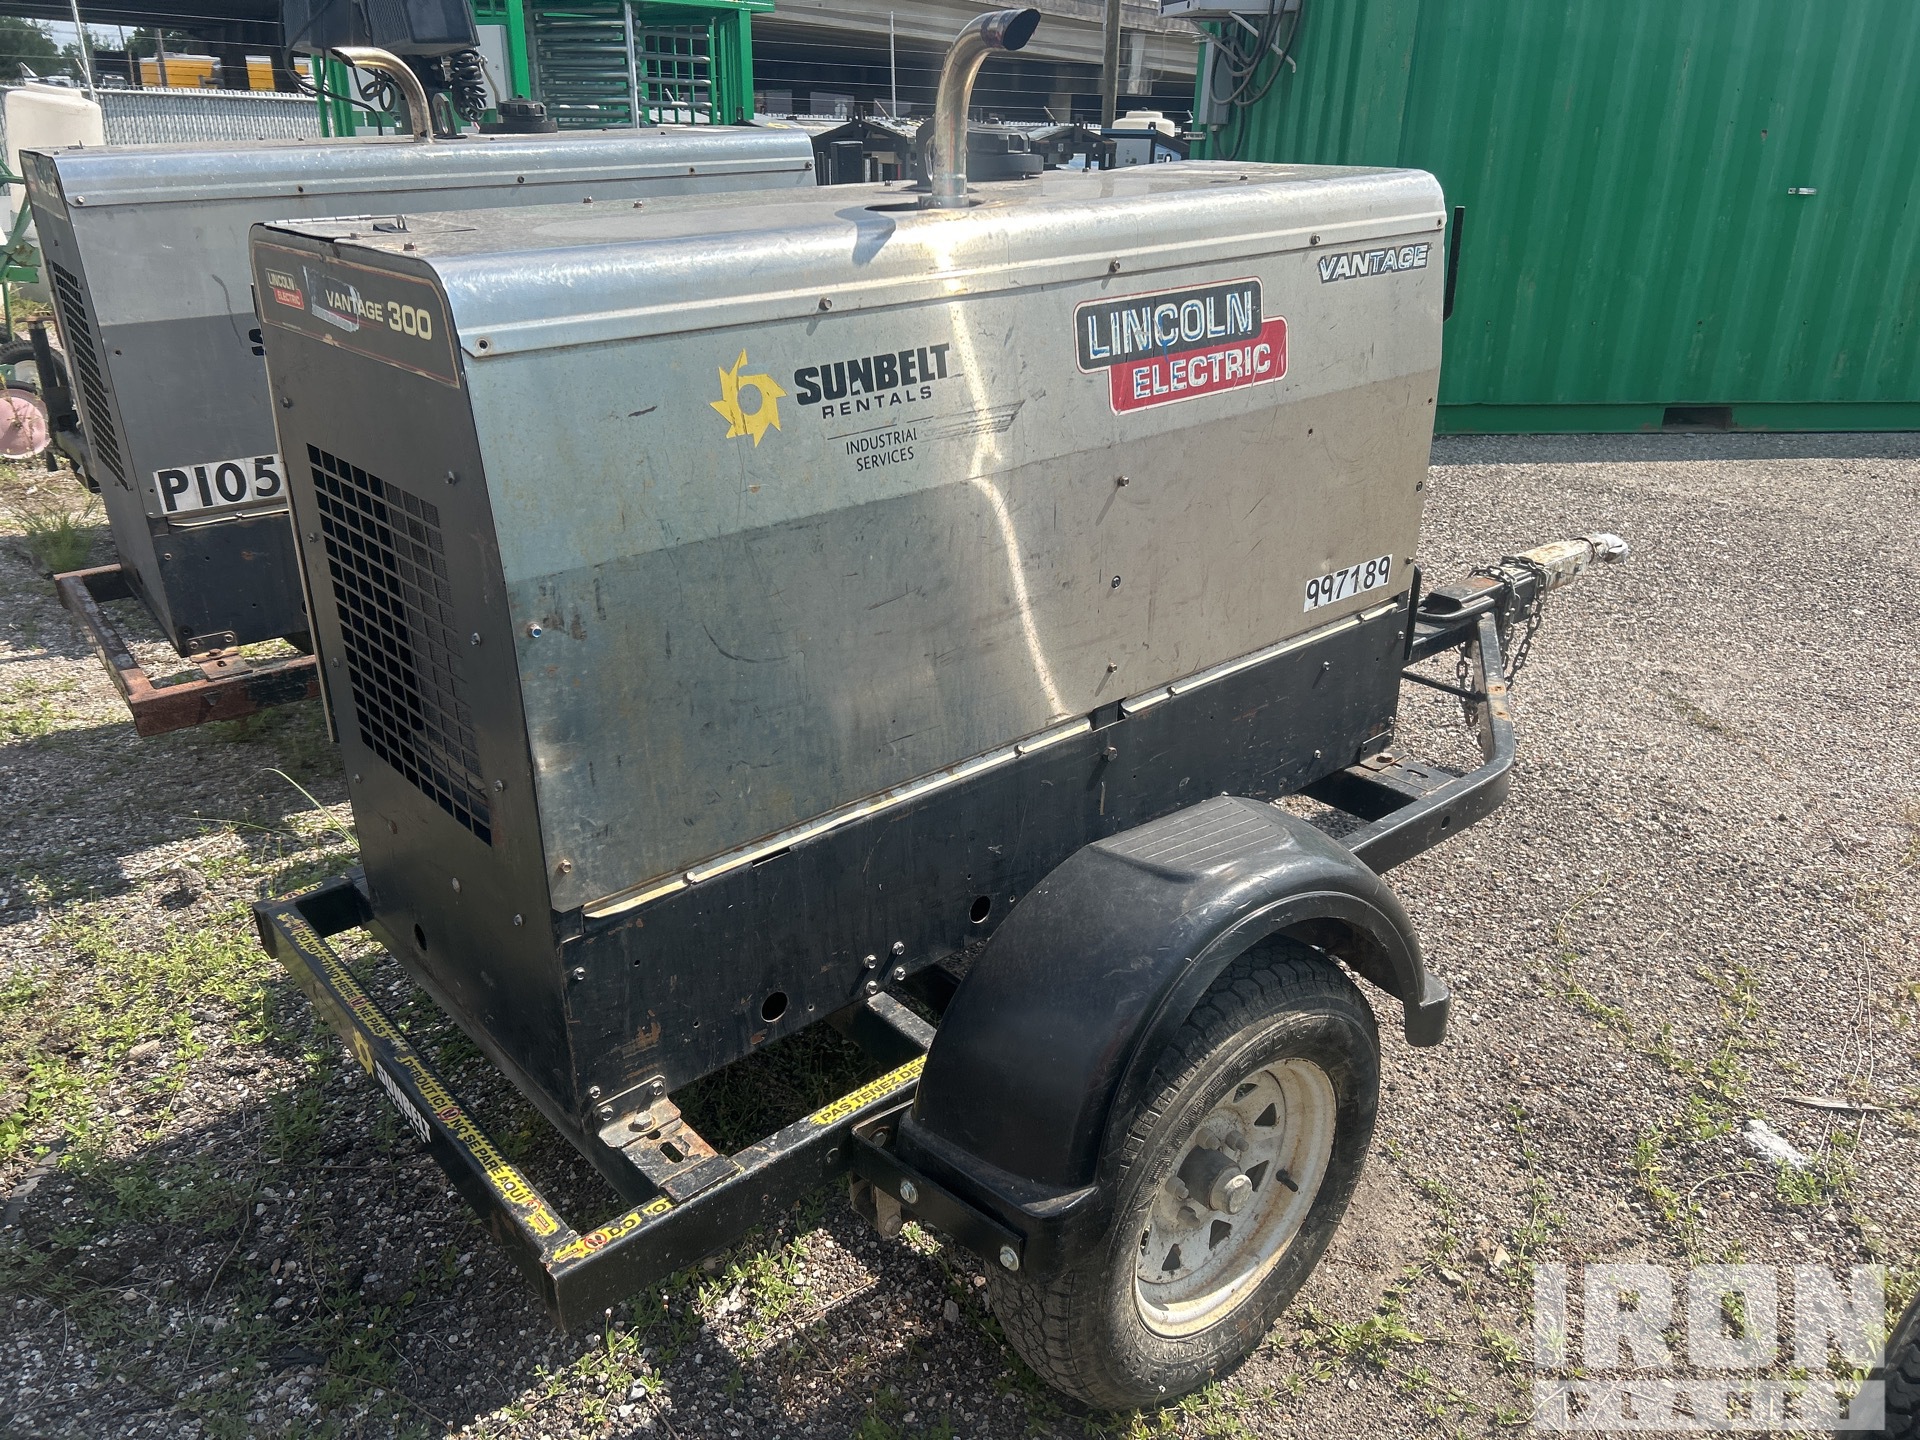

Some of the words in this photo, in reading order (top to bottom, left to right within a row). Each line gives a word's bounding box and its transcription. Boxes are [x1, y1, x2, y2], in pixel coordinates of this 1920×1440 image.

[268, 270, 295, 291] LINCOLN
[1319, 243, 1430, 283] VANTAGE
[277, 290, 301, 306] ELECTRIC
[325, 289, 384, 323] VANTAGE
[387, 301, 433, 340] 300
[1087, 290, 1253, 360] LINCOLN
[794, 343, 950, 405] SUNBELT
[1134, 343, 1271, 400] ELECTRIC
[822, 385, 933, 419] RENTALS
[845, 427, 918, 455] INDUSTRIAL
[856, 446, 915, 472] SERVICES
[1306, 556, 1391, 607] 997189
[303, 940, 320, 958] NOT
[320, 954, 341, 982] STAND
[335, 976, 357, 999] HERE
[358, 1006, 374, 1023] NE
[368, 1018, 386, 1035] PAS
[430, 1093, 449, 1109] ICI
[820, 1102, 852, 1122] PAS
[849, 1076, 900, 1103] TENEZ
[451, 1119, 469, 1135] NO
[463, 1134, 482, 1150] SE
[474, 1148, 504, 1176] PARE
[606, 1217, 637, 1237] DO
